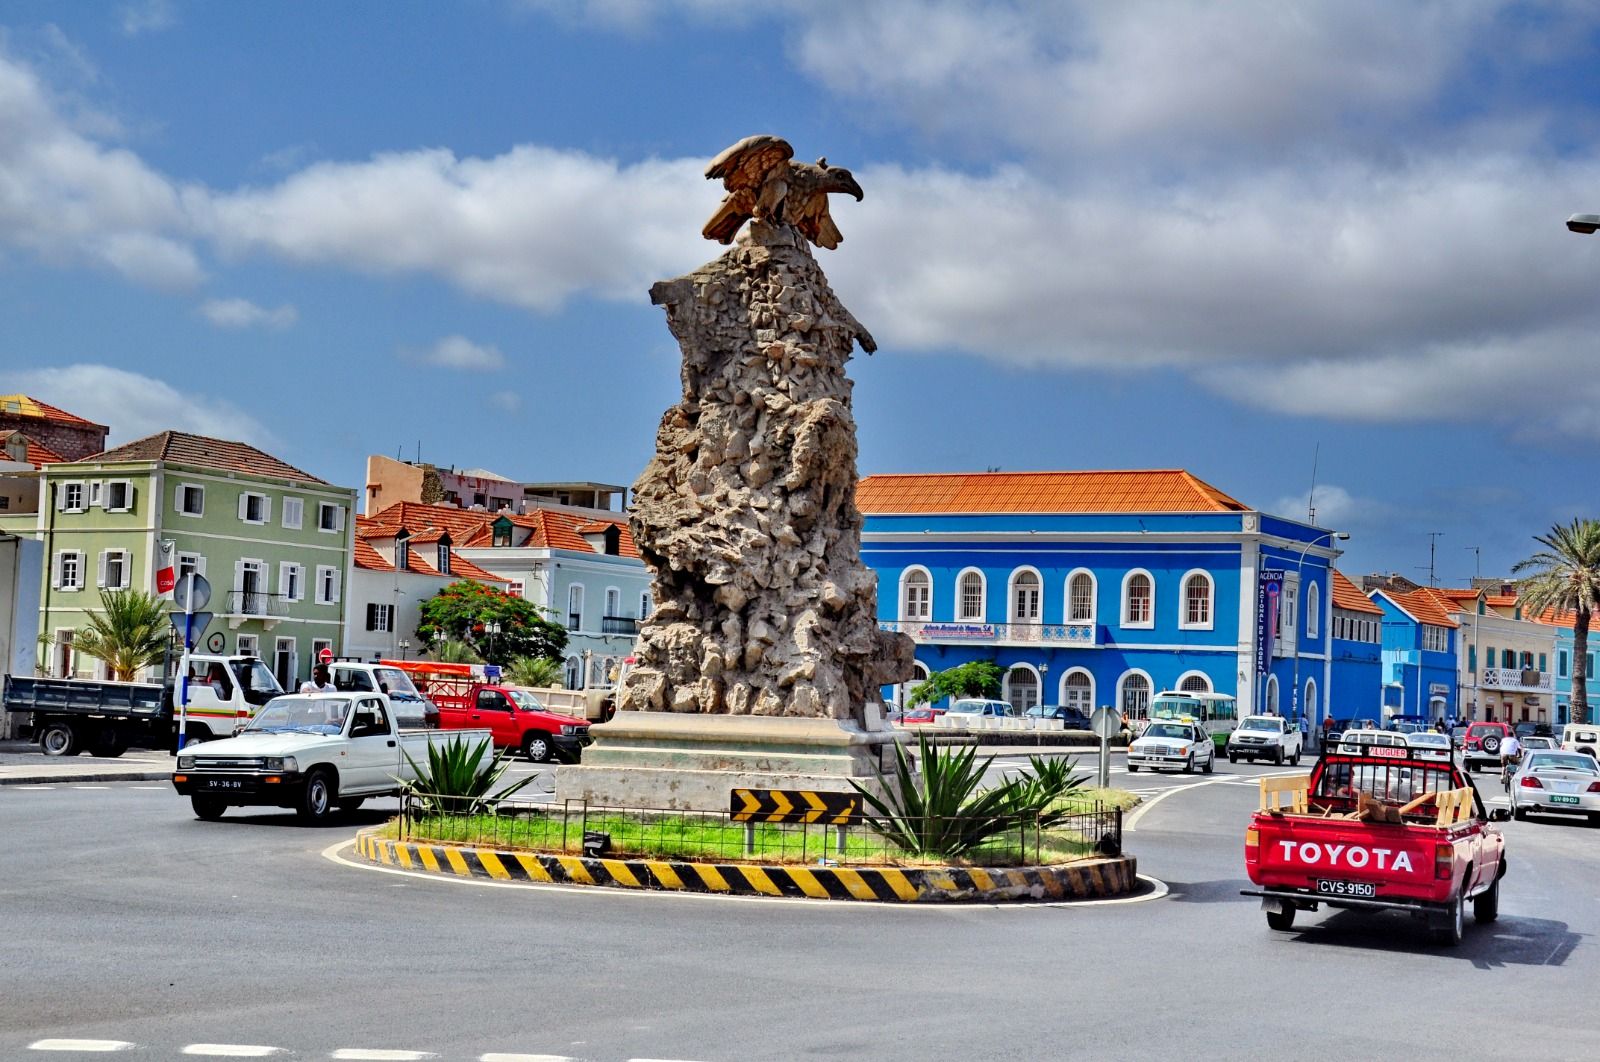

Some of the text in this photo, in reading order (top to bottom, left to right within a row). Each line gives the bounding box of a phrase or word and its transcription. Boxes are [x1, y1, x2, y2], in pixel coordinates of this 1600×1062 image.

[1259, 626, 1264, 635] DE
[1370, 748, 1406, 757] ALUGUER
[1280, 841, 1413, 872] TOYOTA
